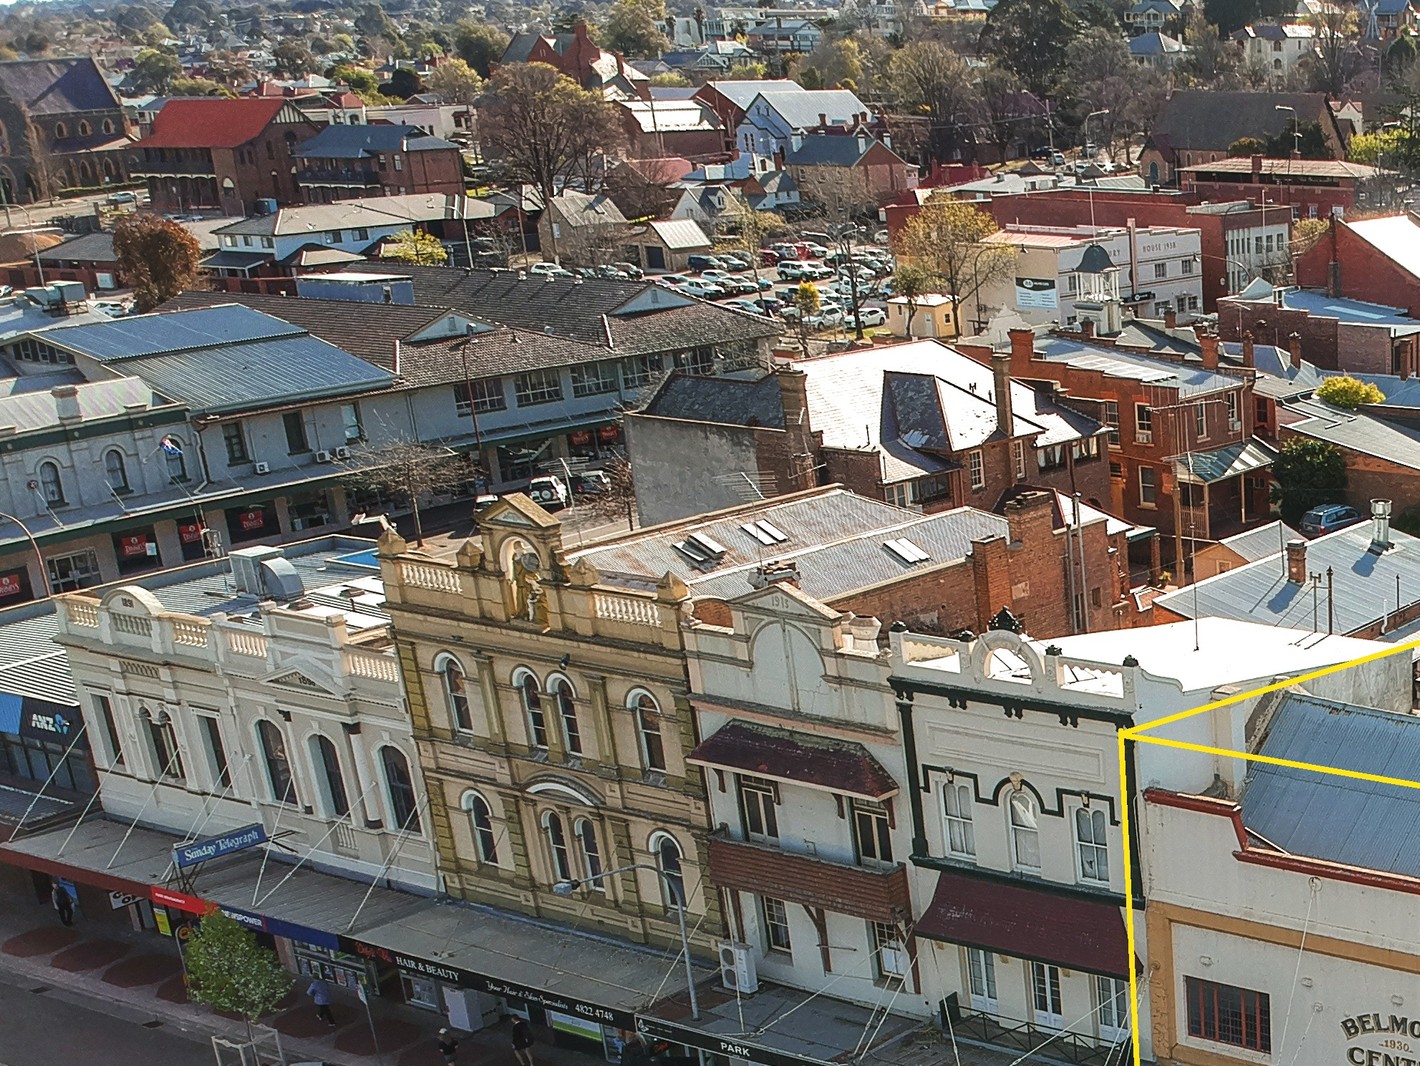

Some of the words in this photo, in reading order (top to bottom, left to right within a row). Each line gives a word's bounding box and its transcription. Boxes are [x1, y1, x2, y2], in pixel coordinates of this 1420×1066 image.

[32, 713, 56, 732] ANZ
[185, 845, 216, 861] Sunday
[216, 830, 259, 852] Telegraph
[396, 956, 416, 970] HAIR
[426, 964, 459, 981] BEAUTY
[575, 1003, 594, 1016] 4822
[595, 1009, 614, 1021] 4748
[720, 1042, 750, 1057] PARK
